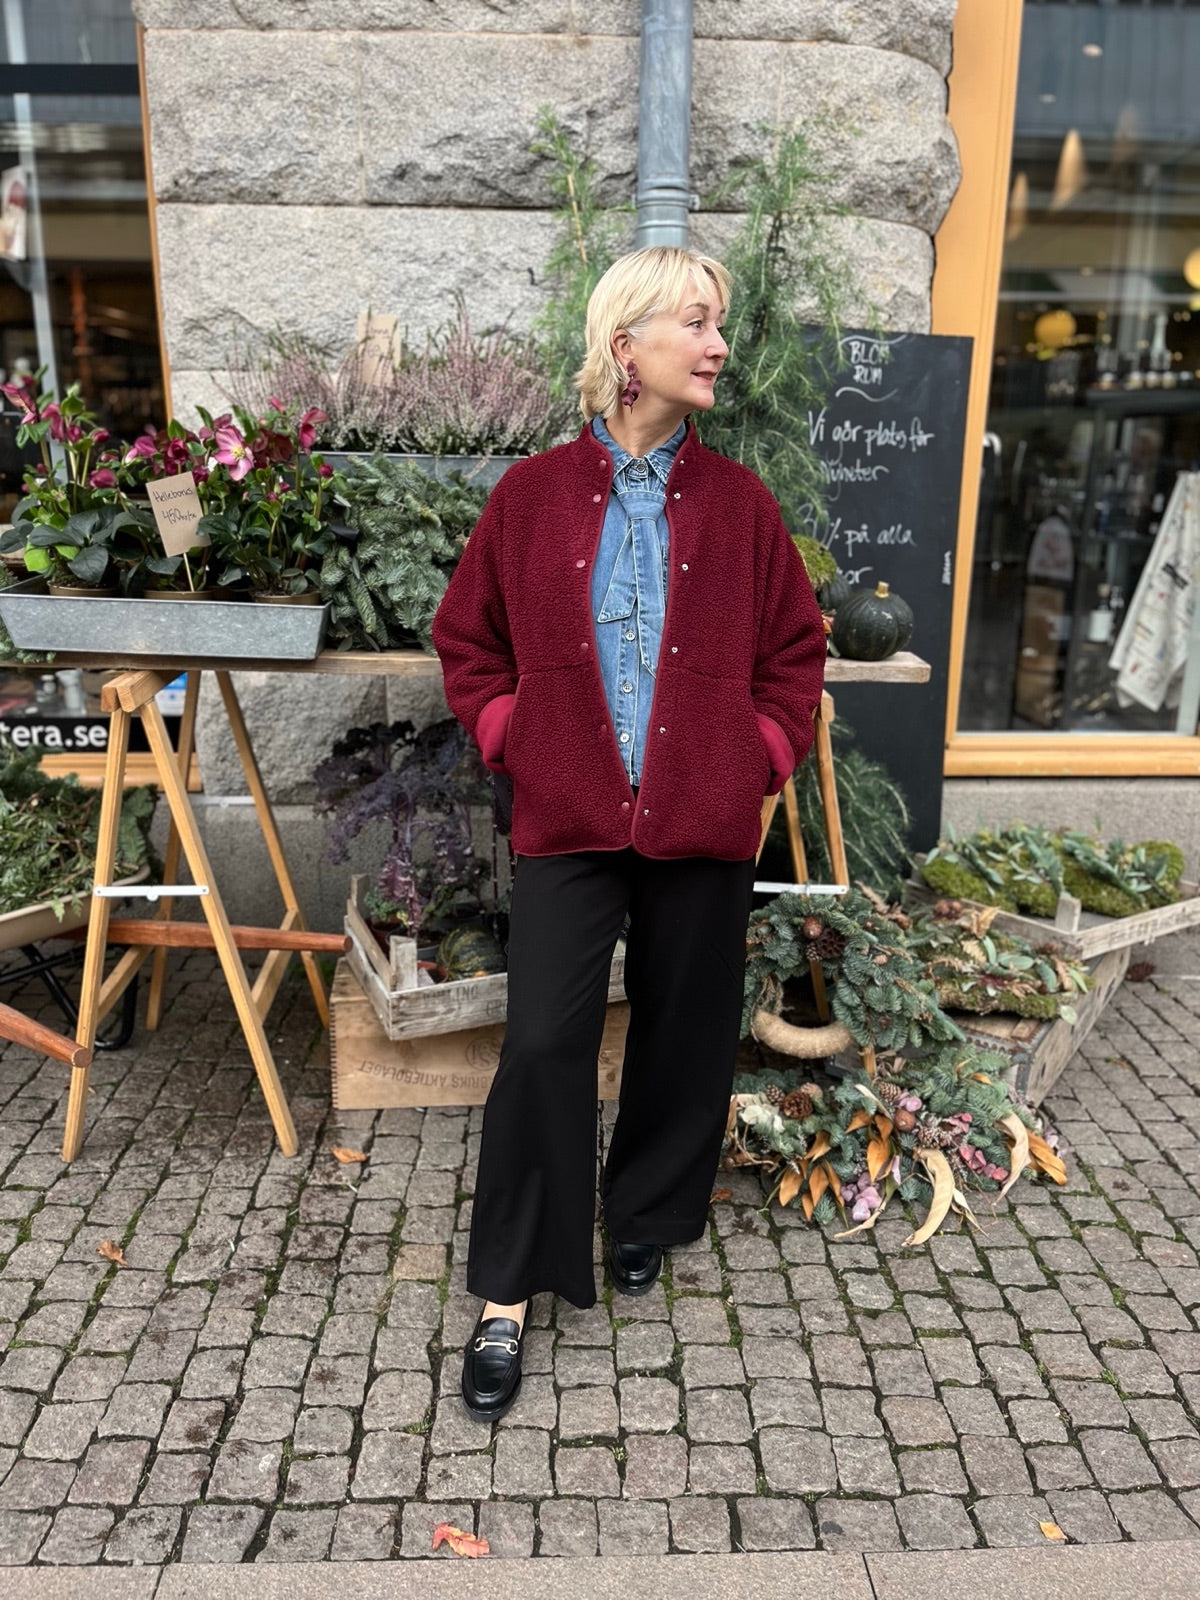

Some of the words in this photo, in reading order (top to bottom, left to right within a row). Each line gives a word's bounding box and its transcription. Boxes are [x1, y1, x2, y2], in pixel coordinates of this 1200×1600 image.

[808, 407, 827, 445] Vi
[863, 420, 908, 456] plats
[843, 523, 871, 558] på
[877, 523, 917, 546] alla
[357, 1060, 447, 1088] AKTIEBOLAGET
